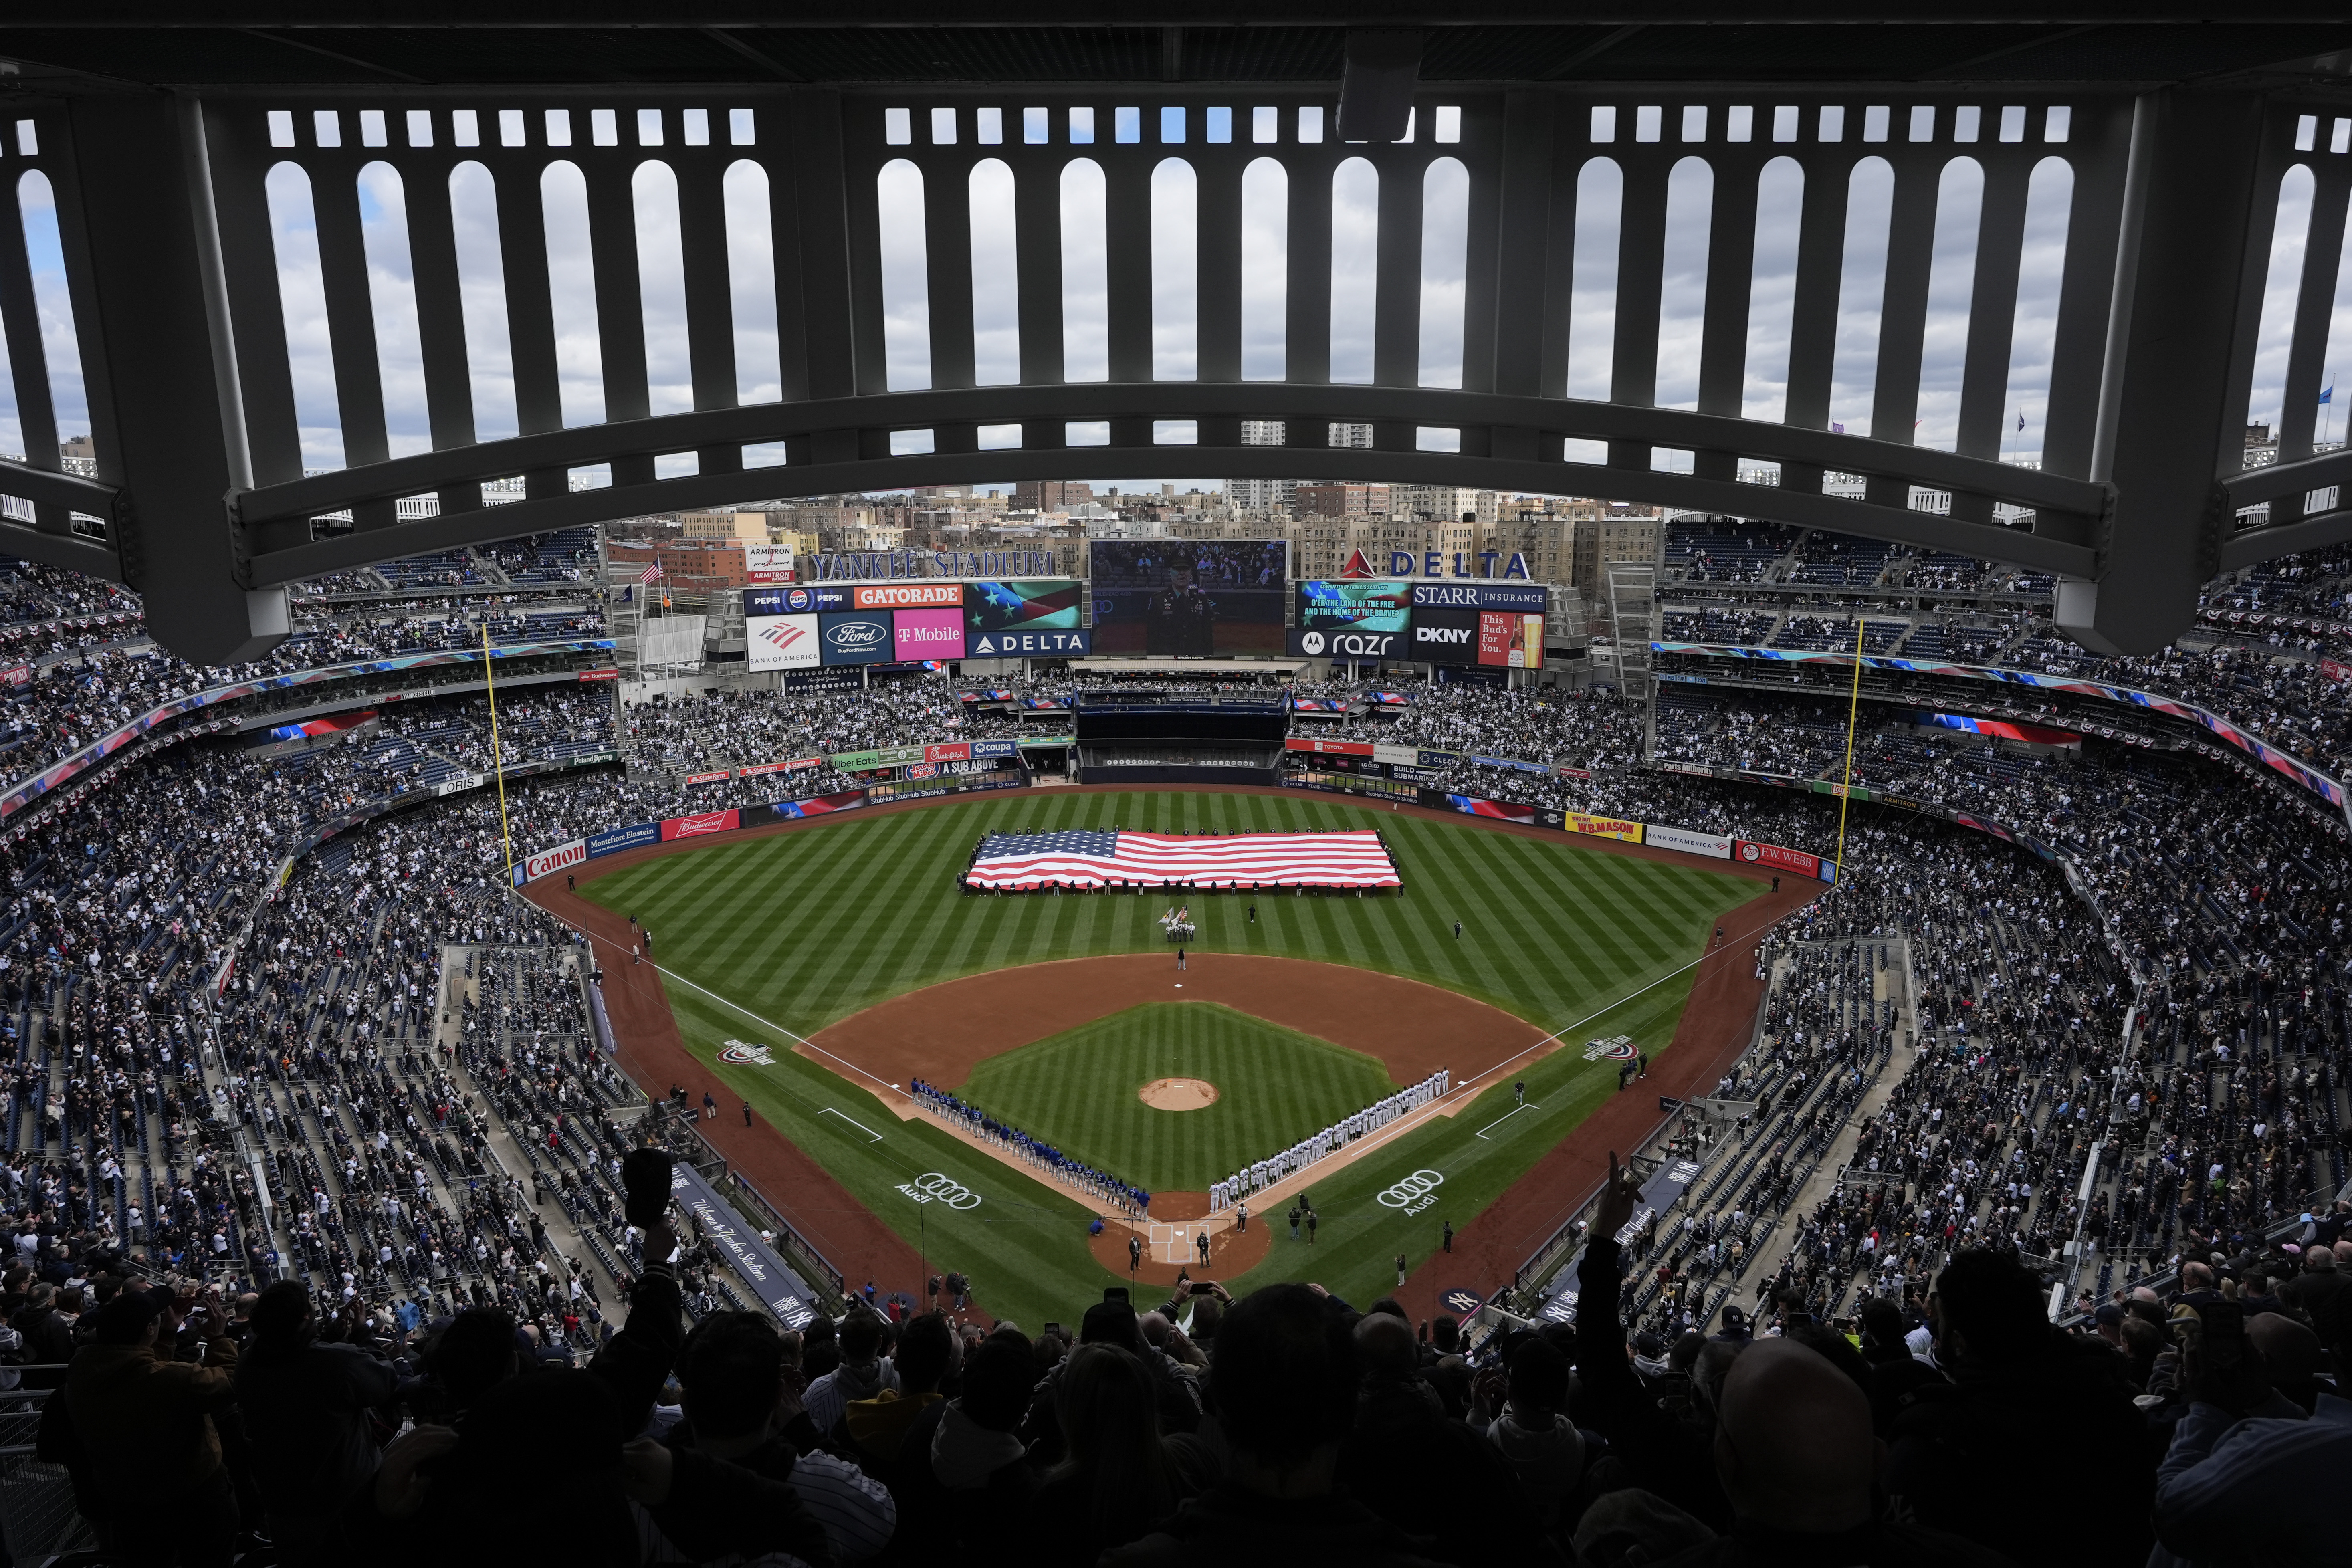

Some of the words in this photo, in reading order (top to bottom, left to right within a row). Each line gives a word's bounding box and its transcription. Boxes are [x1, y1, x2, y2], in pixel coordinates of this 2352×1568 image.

[810, 553, 918, 580] YANKEE
[935, 551, 1054, 577] STADIUM
[1391, 551, 1530, 579] DELTA
[860, 587, 958, 604] GATORADE
[1415, 587, 1479, 605] STARR
[1485, 593, 1543, 603] INSURANCE
[1482, 614, 1503, 624] This
[837, 626, 876, 642] Ford
[899, 628, 910, 642] T
[914, 627, 960, 641] Mobile
[1417, 627, 1472, 644] DKNY
[1482, 624, 1508, 634] Bud's
[1003, 635, 1083, 651] DELTA
[1333, 634, 1394, 655] razr
[1482, 634, 1498, 643] For
[1482, 643, 1502, 653] You.
[16, 668, 28, 682] DECK
[986, 744, 1011, 752] coupa
[574, 755, 594, 765] Poland
[594, 753, 613, 764] Spring
[835, 760, 854, 768] Uber
[856, 757, 876, 765] Eats
[943, 763, 949, 774] A
[951, 761, 969, 773] SUB
[971, 758, 998, 771] ABOVE
[911, 762, 935, 772] Jersey
[1682, 764, 1713, 775] Authority
[913, 769, 935, 780] Mike's
[447, 778, 474, 793] ORIS
[392, 797, 411, 806] ARMITRON
[411, 793, 422, 801] 12:59
[871, 796, 894, 805] StubHub
[895, 792, 919, 800] StubHub
[1884, 797, 1916, 808] ARMITRON
[1920, 804, 1934, 814] 12:59
[680, 819, 722, 833] Budweiser
[1578, 822, 1634, 835] W.B.MASON
[591, 835, 625, 848] Montefiore
[626, 828, 654, 839] Einstein
[1679, 838, 1712, 848] AMERICA
[527, 845, 584, 877] Canon
[1761, 847, 1779, 860] F.W.
[1783, 851, 1812, 868] WEBB
[1823, 868, 1833, 876] YORK
[724, 1039, 762, 1058] OPENING
[753, 1055, 776, 1066] DAY
[1582, 1042, 1620, 1061] OPENING
[1611, 1034, 1632, 1045] DAY
[1667, 1170, 1679, 1180] NEW
[1672, 1172, 1686, 1183] YORK
[1679, 1175, 1692, 1184] LIFE
[894, 1184, 933, 1204] Audi
[691, 1199, 717, 1226] Welcome
[1404, 1194, 1439, 1217] Audi
[713, 1223, 726, 1232] to
[710, 1228, 747, 1254] Yankee
[738, 1253, 767, 1281] Stadium
[786, 1296, 801, 1308] NEW
[1559, 1289, 1573, 1304] NEW
[772, 1302, 785, 1314] LIFE
[778, 1296, 797, 1312] YORK
